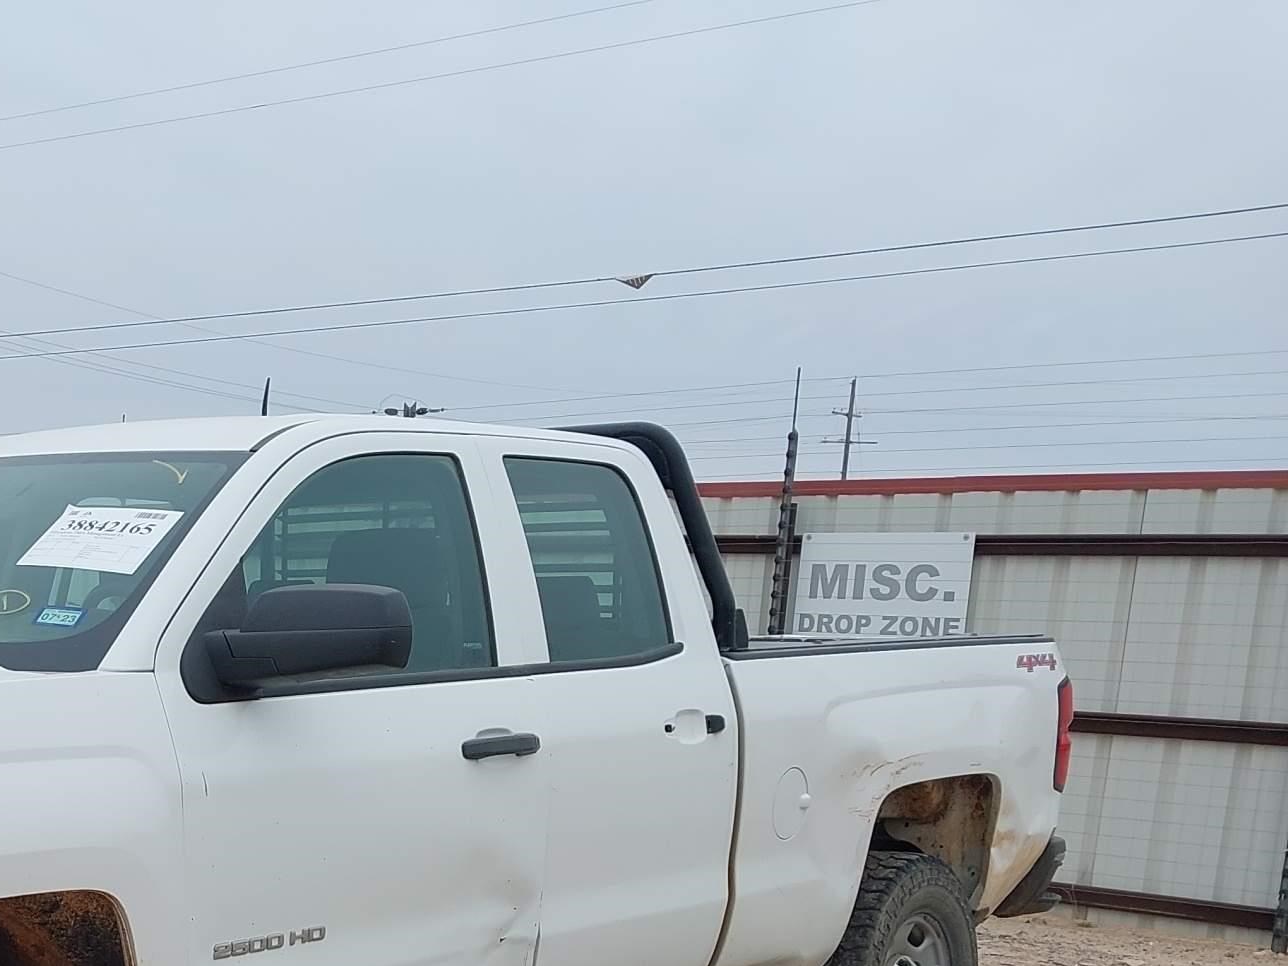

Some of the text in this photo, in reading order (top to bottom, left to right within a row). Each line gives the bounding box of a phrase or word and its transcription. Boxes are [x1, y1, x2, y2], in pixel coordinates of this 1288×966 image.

[60, 519, 157, 535] 38842165
[808, 563, 955, 601] MISC.
[798, 613, 961, 637] DROP ZONE
[213, 926, 326, 960] 2500 HD
